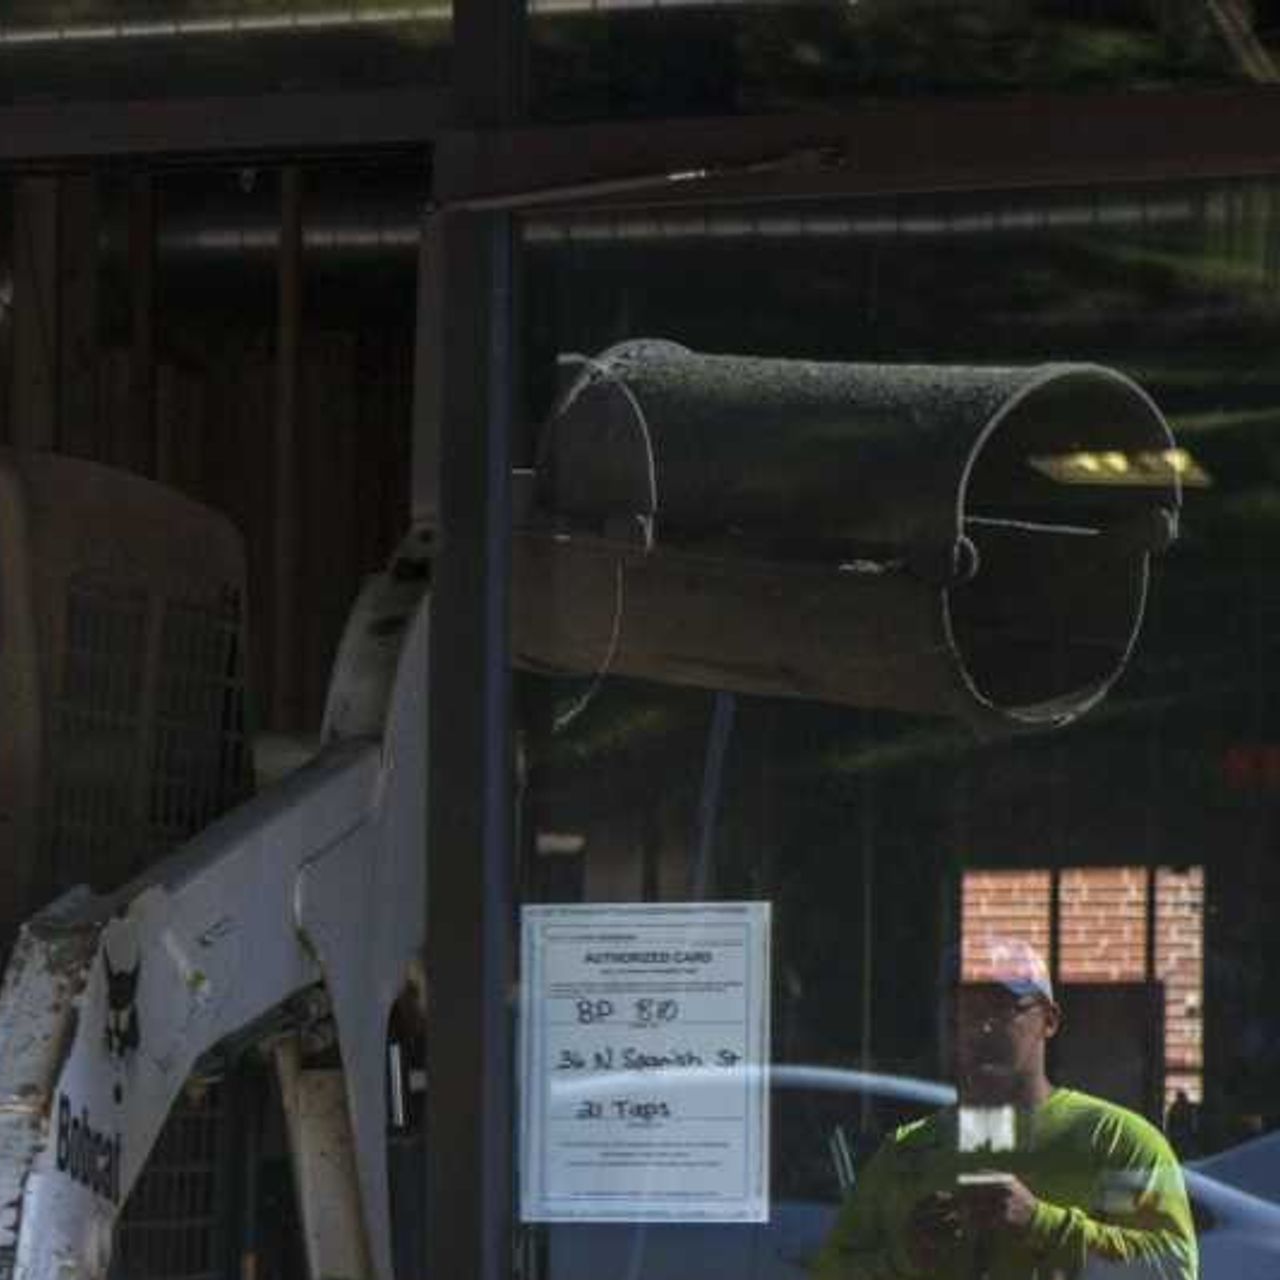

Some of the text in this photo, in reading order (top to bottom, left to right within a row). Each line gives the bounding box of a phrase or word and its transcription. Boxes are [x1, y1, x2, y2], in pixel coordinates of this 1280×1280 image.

[584, 950, 713, 964] AUTHORIZED CARD
[57, 1093, 121, 1206] Bobcat
